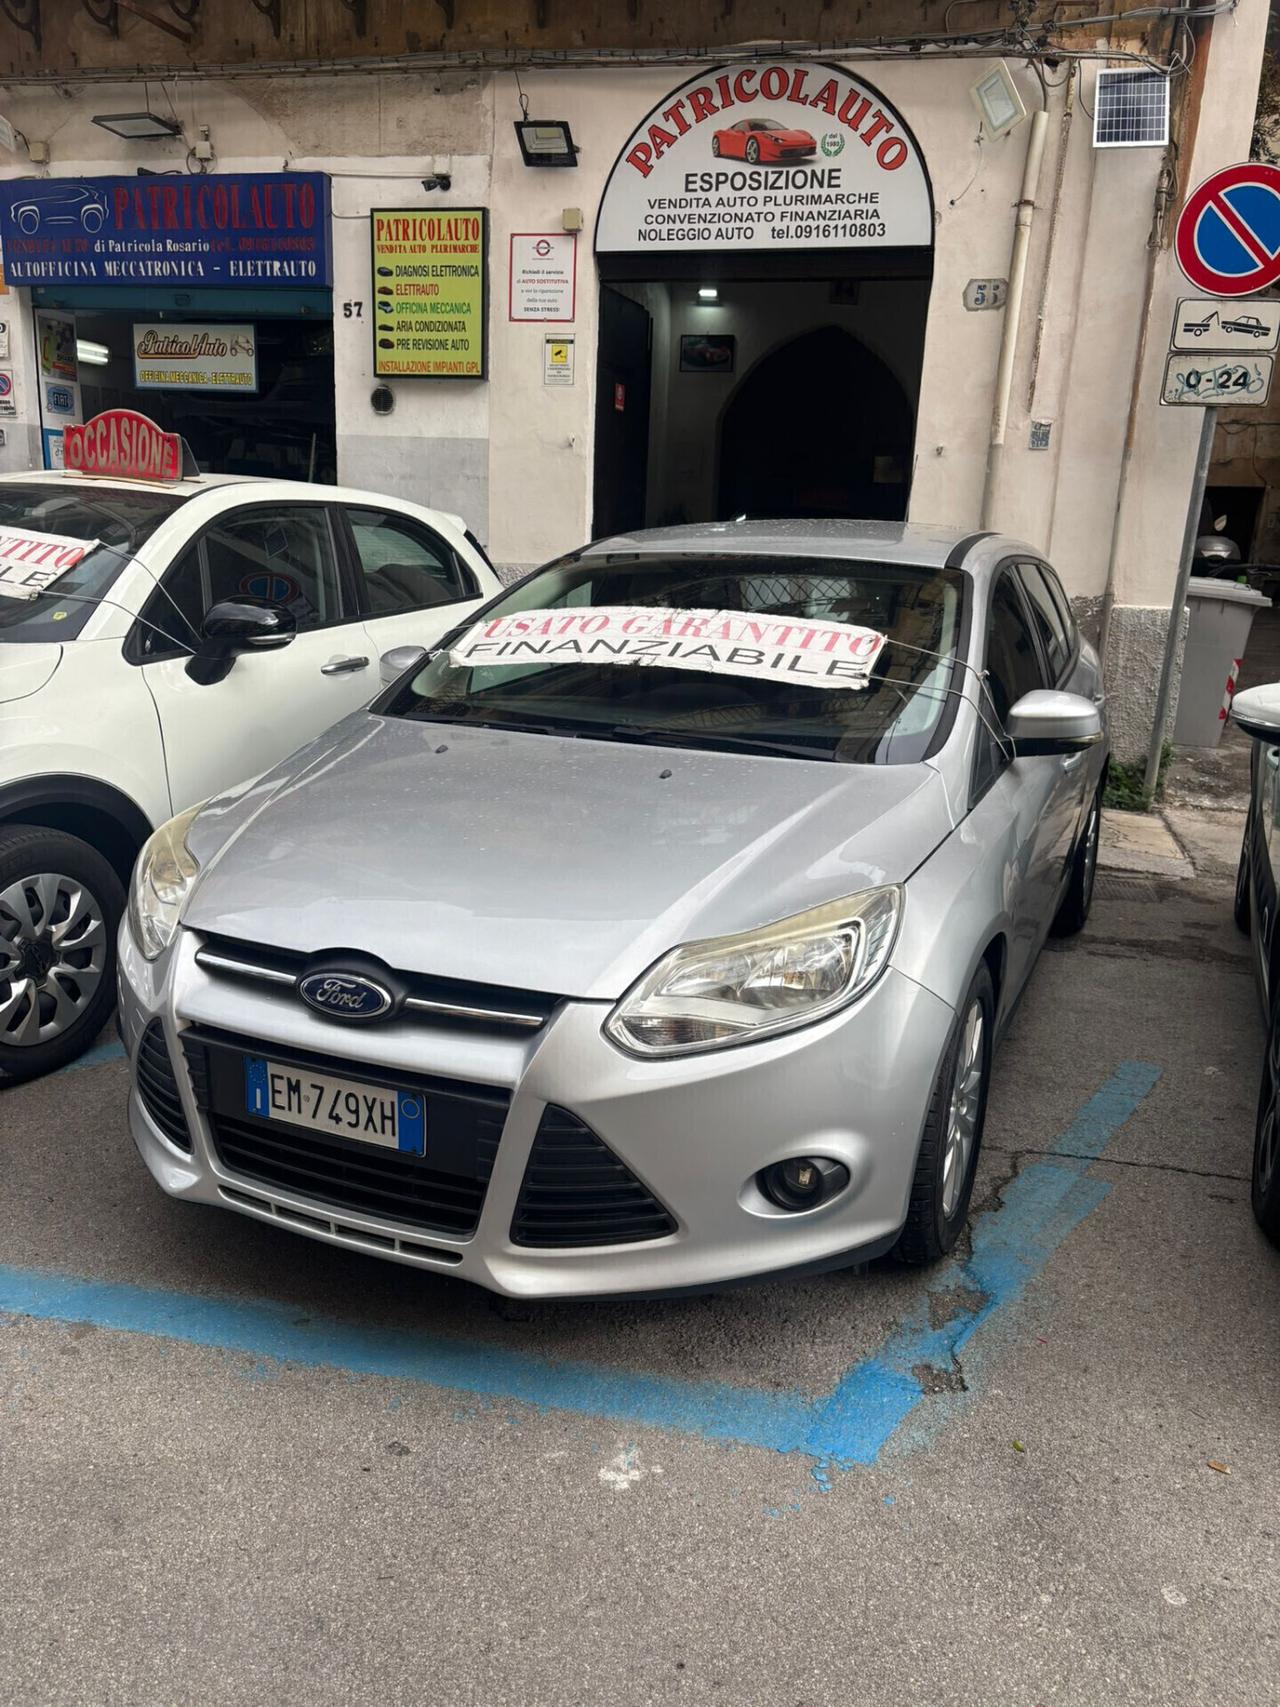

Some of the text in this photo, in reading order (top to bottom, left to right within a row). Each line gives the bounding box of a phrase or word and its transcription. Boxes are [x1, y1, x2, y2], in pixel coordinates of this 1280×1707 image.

[626, 67, 908, 178] PATRICOLAUTO
[684, 168, 842, 192] ESPOSIZIONE
[113, 182, 315, 231] PATRICOLAUTO
[648, 192, 880, 209] VENDITA AUTO PLURIMARCHE
[644, 209, 881, 225] CONVENZIONATO FINANZIARIA
[376, 217, 480, 242] PATRICOLAUTO
[638, 222, 886, 242] NOLEGGIO AUTO tel.0916110803
[94, 239, 105, 252] di
[109, 239, 163, 253] Patricola
[166, 239, 210, 252] Rosario
[410, 244, 427, 254] AUTO
[10, 260, 97, 277] AUTOFFICINA
[104, 260, 205, 277] MECCATRONICA
[230, 260, 316, 277] ELETTRAUTO
[396, 265, 479, 278] DIAGNOSI ELETTRONICA
[396, 284, 440, 296] ELETTRAUTO
[344, 302, 364, 318] 57
[396, 302, 472, 314] OFFICINA MECCANICA
[396, 320, 466, 332] ARIA CONDIZIONATA
[396, 339, 470, 351] PRE REVISIONE AUTO
[379, 361, 431, 373] INSTALLAZIONE
[433, 361, 464, 373] IMPIANTI
[70, 417, 173, 475] OCCASIONE
[484, 615, 881, 657] USATO GARANTITO
[466, 639, 868, 680] FINANZIABILE
[316, 979, 368, 1010] Ford
[270, 1073, 396, 1137] EM749XH
